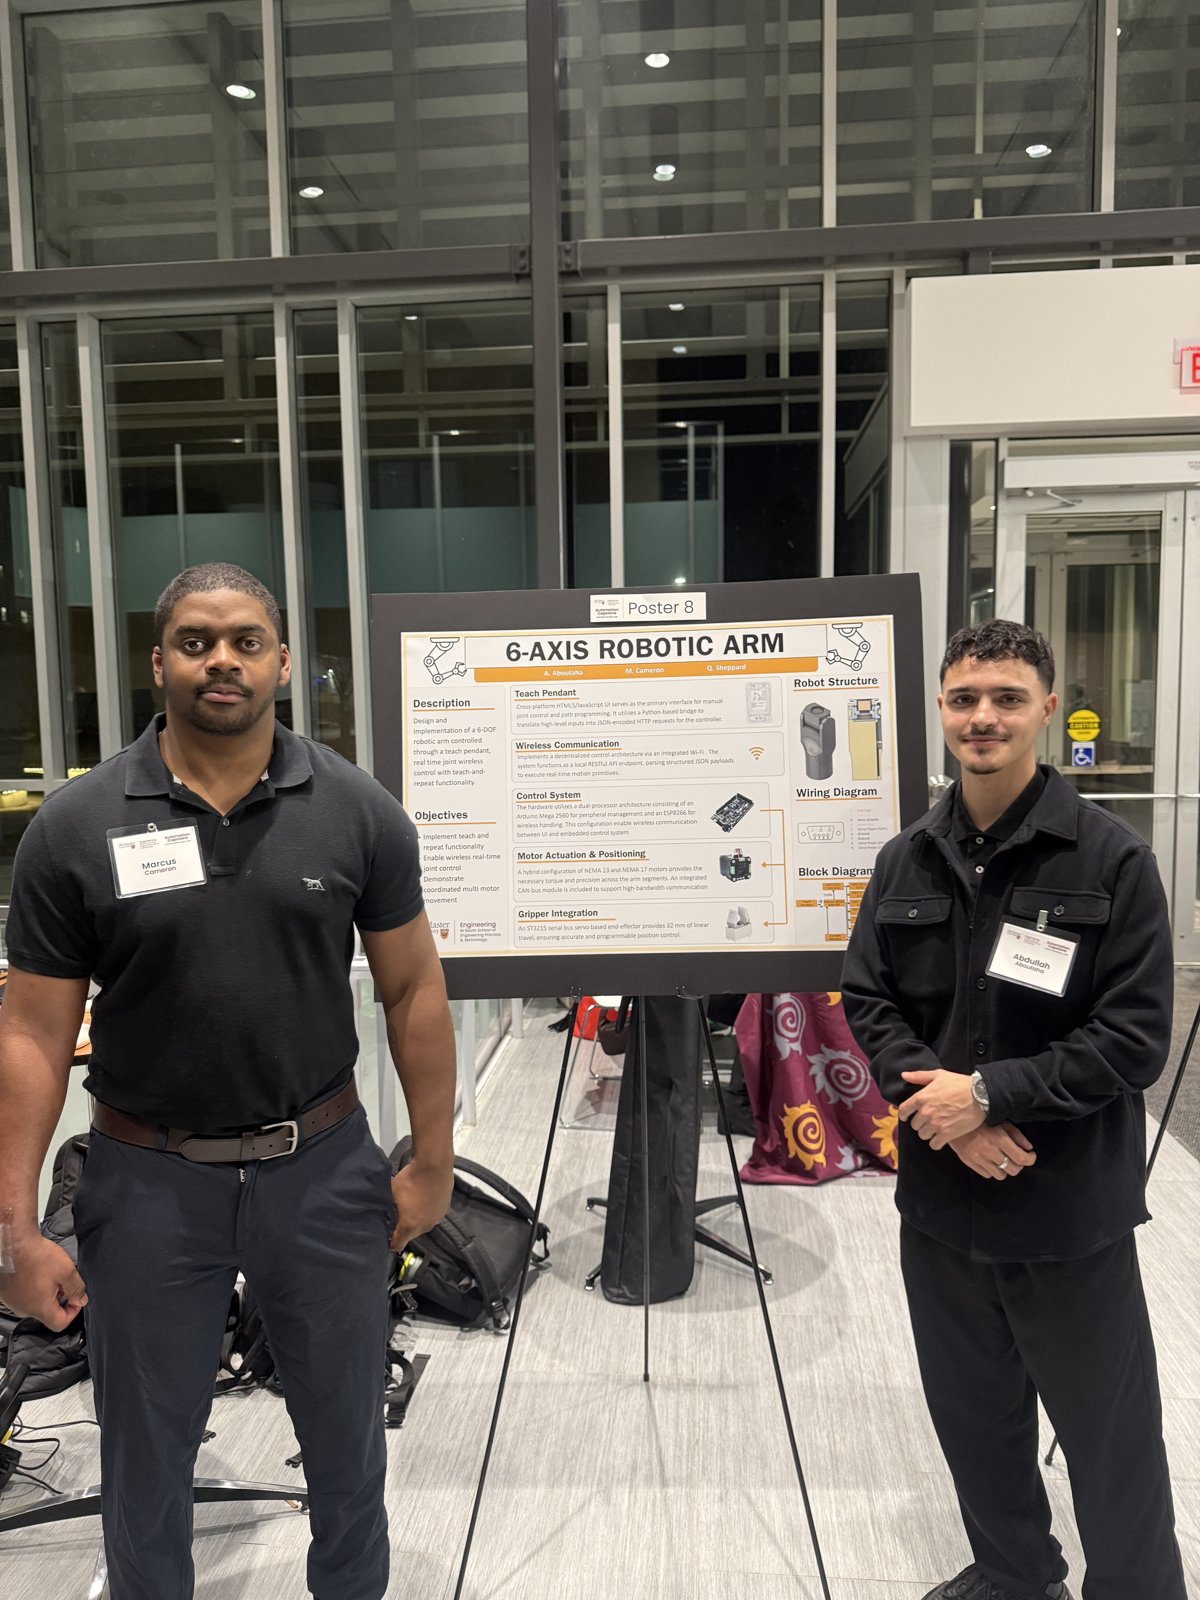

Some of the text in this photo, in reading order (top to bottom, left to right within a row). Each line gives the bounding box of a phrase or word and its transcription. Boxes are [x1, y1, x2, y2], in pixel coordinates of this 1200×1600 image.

[629, 602, 679, 614] Poster
[684, 600, 694, 613] 8
[506, 633, 784, 661] 6-AXIS ROBOTIC ARM
[794, 677, 878, 687] Robot Structure
[413, 699, 470, 708] Description
[414, 717, 435, 725] Design
[541, 720, 568, 728] high-level
[652, 716, 676, 724] requests
[414, 726, 463, 735] implementation
[554, 740, 619, 748] Communication
[414, 748, 439, 757] through
[443, 758, 457, 766] joint
[414, 779, 434, 788] repeat
[550, 792, 581, 800] System
[796, 788, 877, 799] Wiring Diagram
[415, 811, 468, 822] Objectives
[608, 810, 644, 818] management
[577, 820, 613, 828] configuration
[424, 833, 457, 842] Implement
[424, 843, 485, 852] repeat functionality
[546, 851, 586, 859] Actuation
[599, 850, 646, 858] Positioning
[142, 859, 176, 869] Marcus
[145, 866, 176, 876] Cameron
[424, 865, 438, 873] joint
[541, 868, 577, 876] configuration
[798, 867, 828, 876] Block
[518, 909, 598, 919] Gripper Integration
[597, 932, 637, 940] programmable
[1013, 954, 1050, 969] Abdullah
[1015, 962, 1044, 973] Aboutaha
